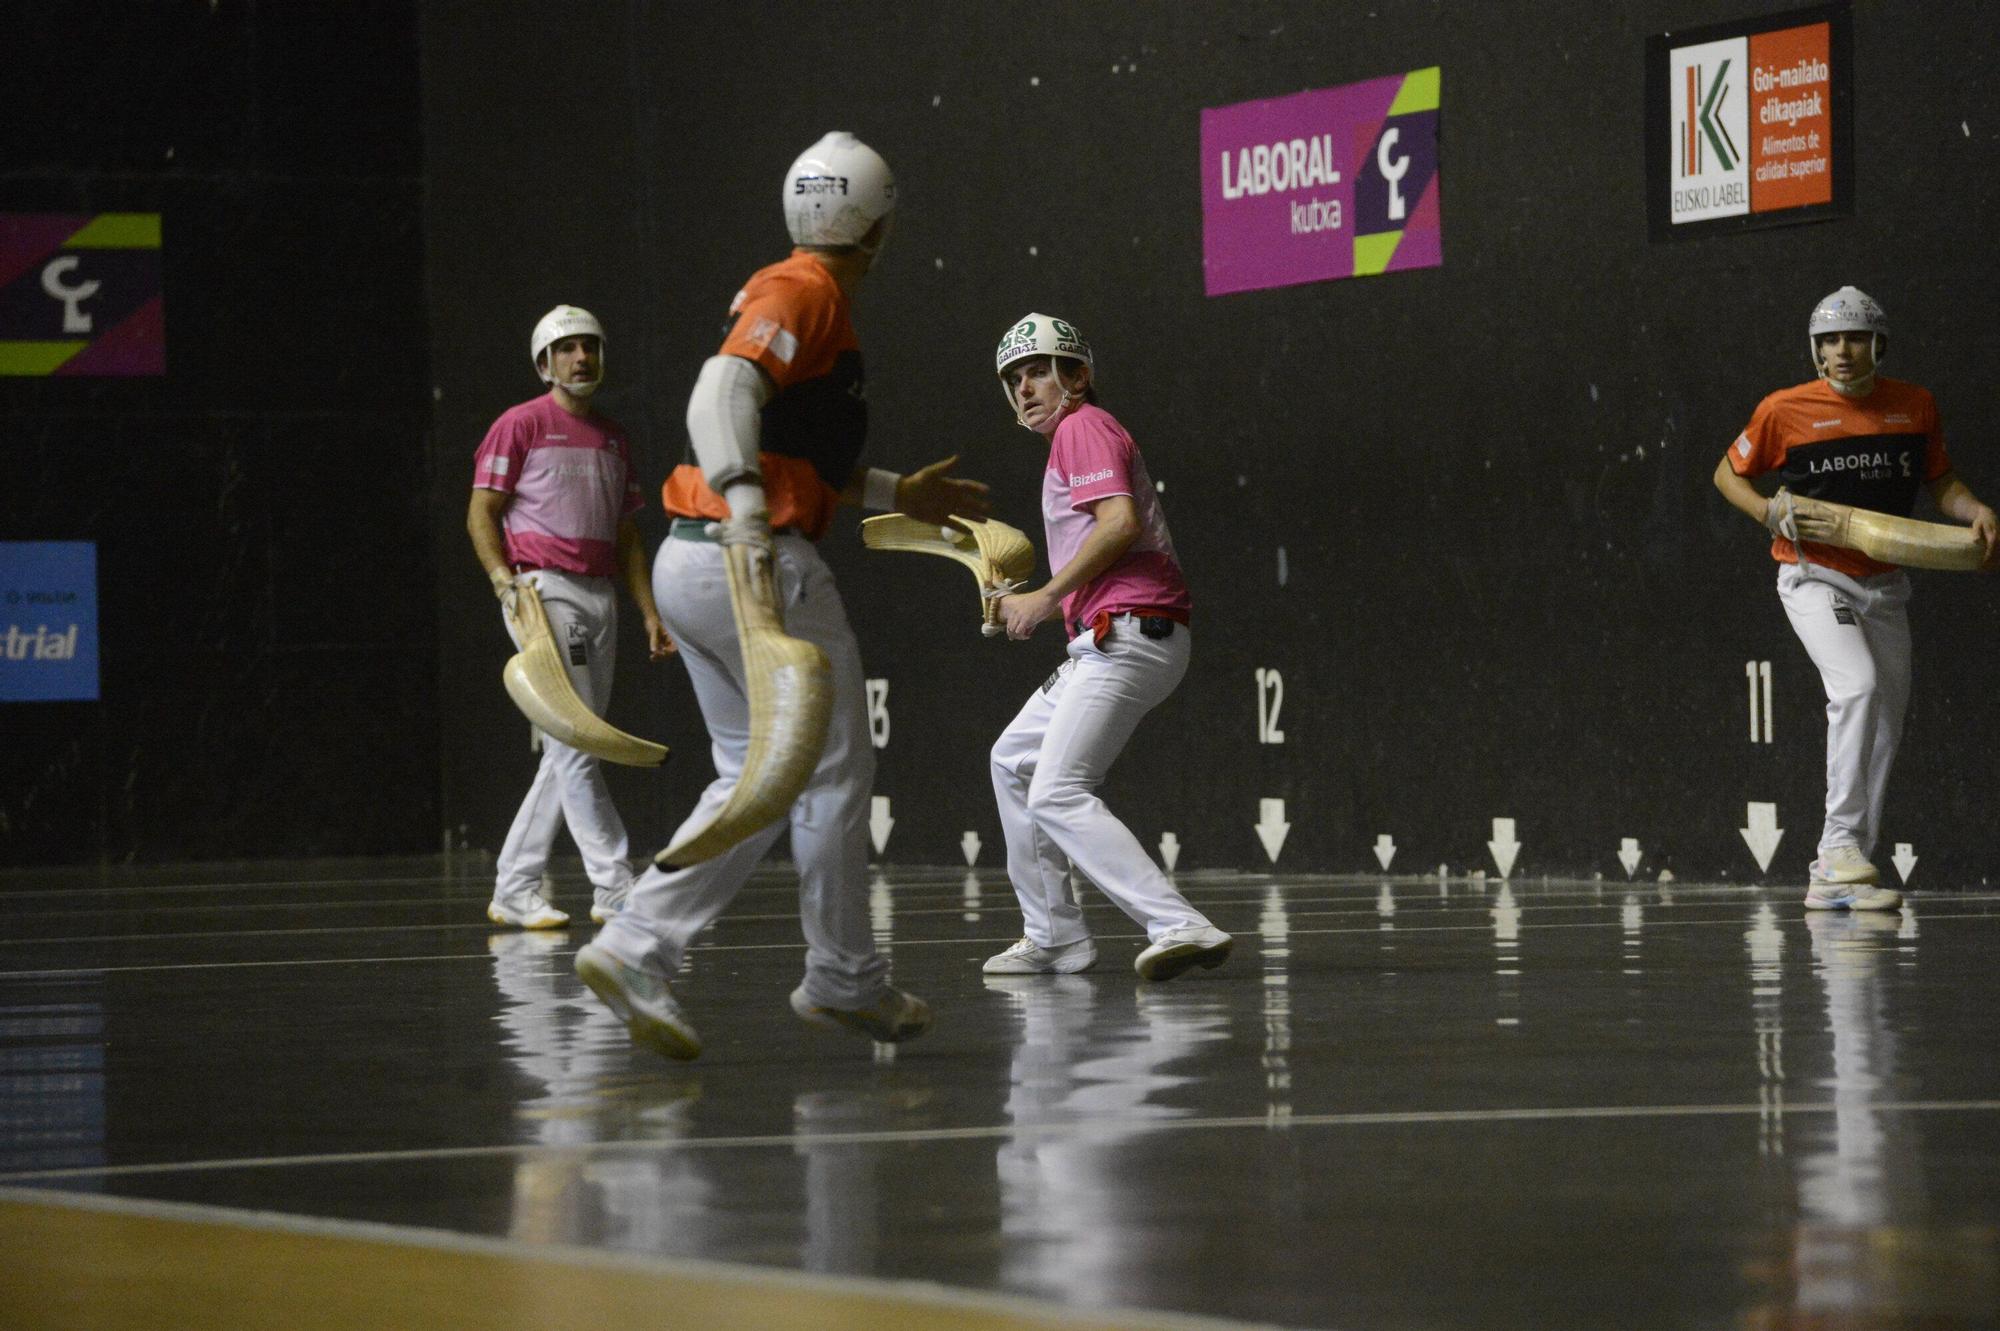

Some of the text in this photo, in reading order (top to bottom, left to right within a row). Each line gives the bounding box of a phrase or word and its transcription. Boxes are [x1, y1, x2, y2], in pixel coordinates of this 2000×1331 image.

[1754, 57, 1828, 92] Goi-mailako
[1760, 90, 1822, 127] elikagaiak
[1762, 129, 1820, 156] Alimentos de
[1221, 134, 1341, 200] LABORAL
[1756, 153, 1827, 182] calidad superior
[1674, 182, 1747, 212] EUSKO LABEL
[1291, 197, 1341, 234] kutxa
[1073, 468, 1114, 487] Bizkaia
[1810, 452, 1892, 474] LABORAL
[1256, 667, 1285, 744] 12
[1746, 660, 1773, 744] 11
